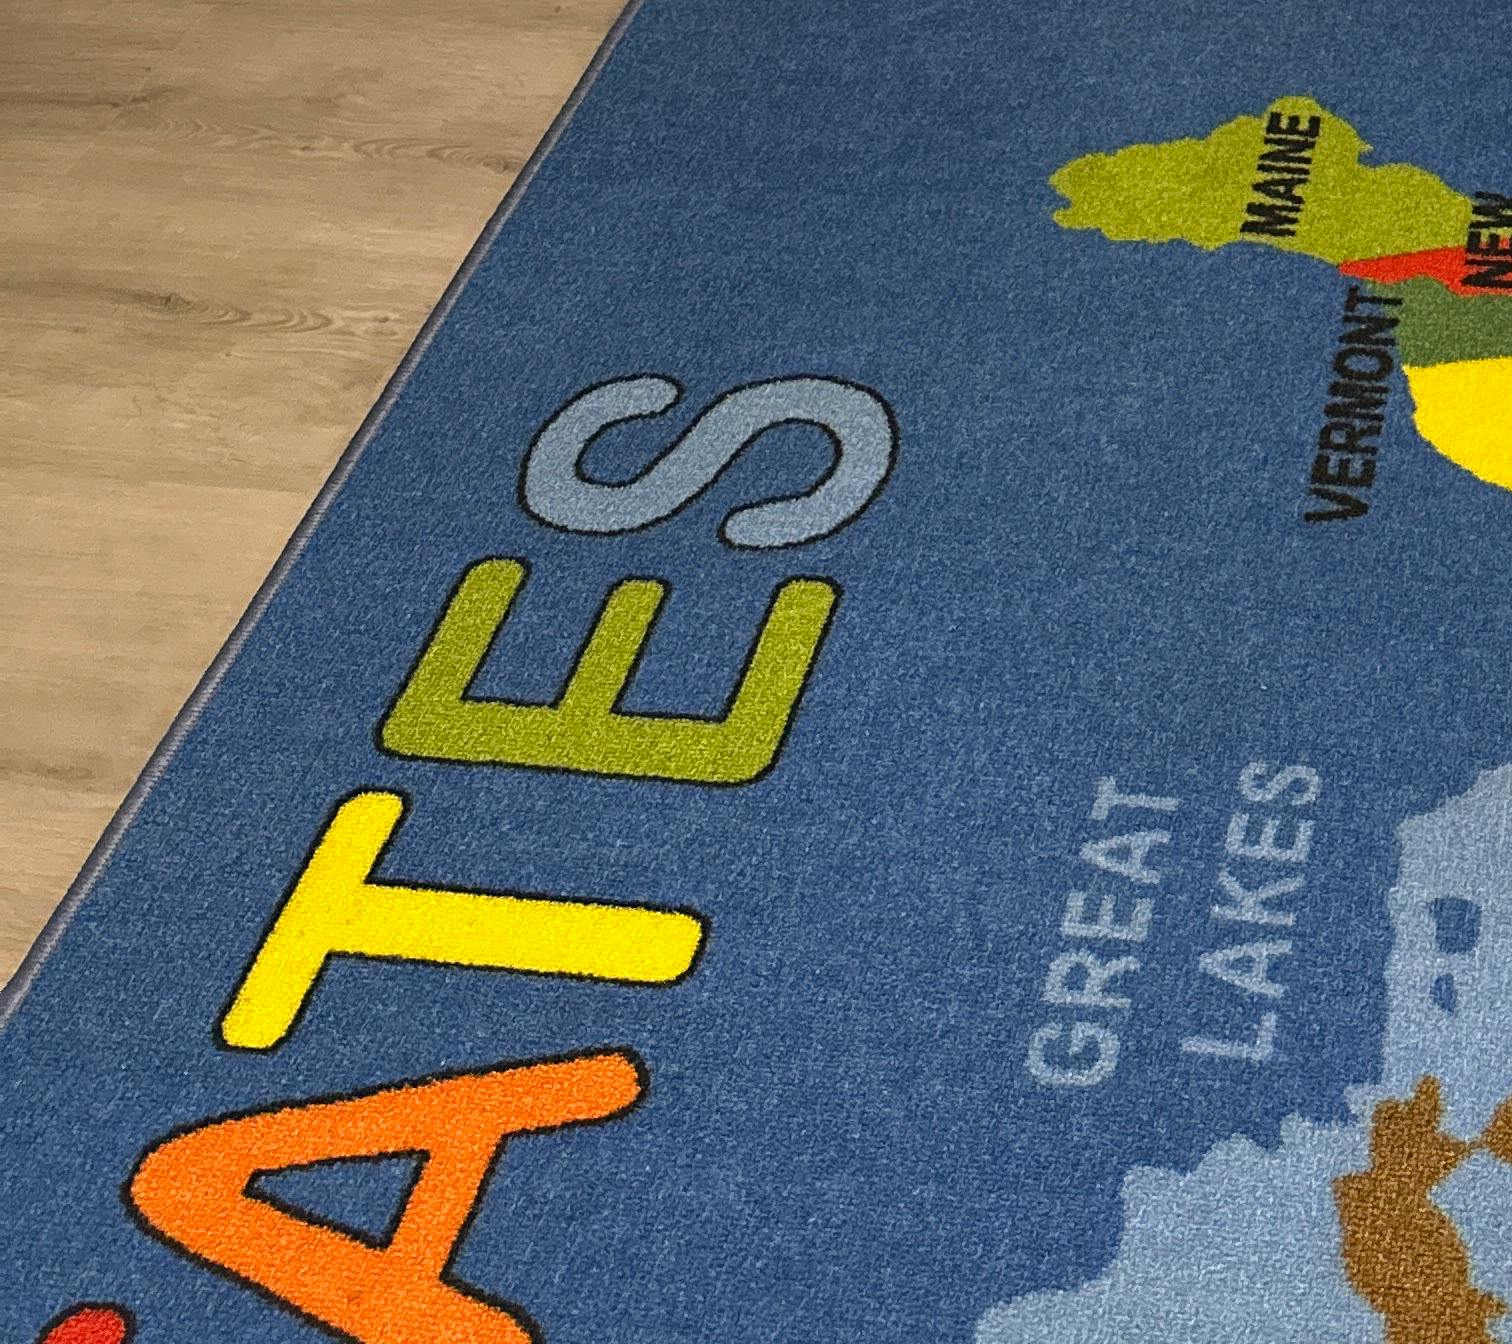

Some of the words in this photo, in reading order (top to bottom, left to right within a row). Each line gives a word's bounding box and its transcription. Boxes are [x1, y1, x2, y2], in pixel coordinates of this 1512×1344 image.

[1240, 108, 1323, 241] MAINE
[1303, 285, 1403, 524] VERMONT
[37, 374, 899, 1344] ATES
[1026, 775, 1181, 1089] GREAT
[1181, 759, 1326, 1065] LAKES
